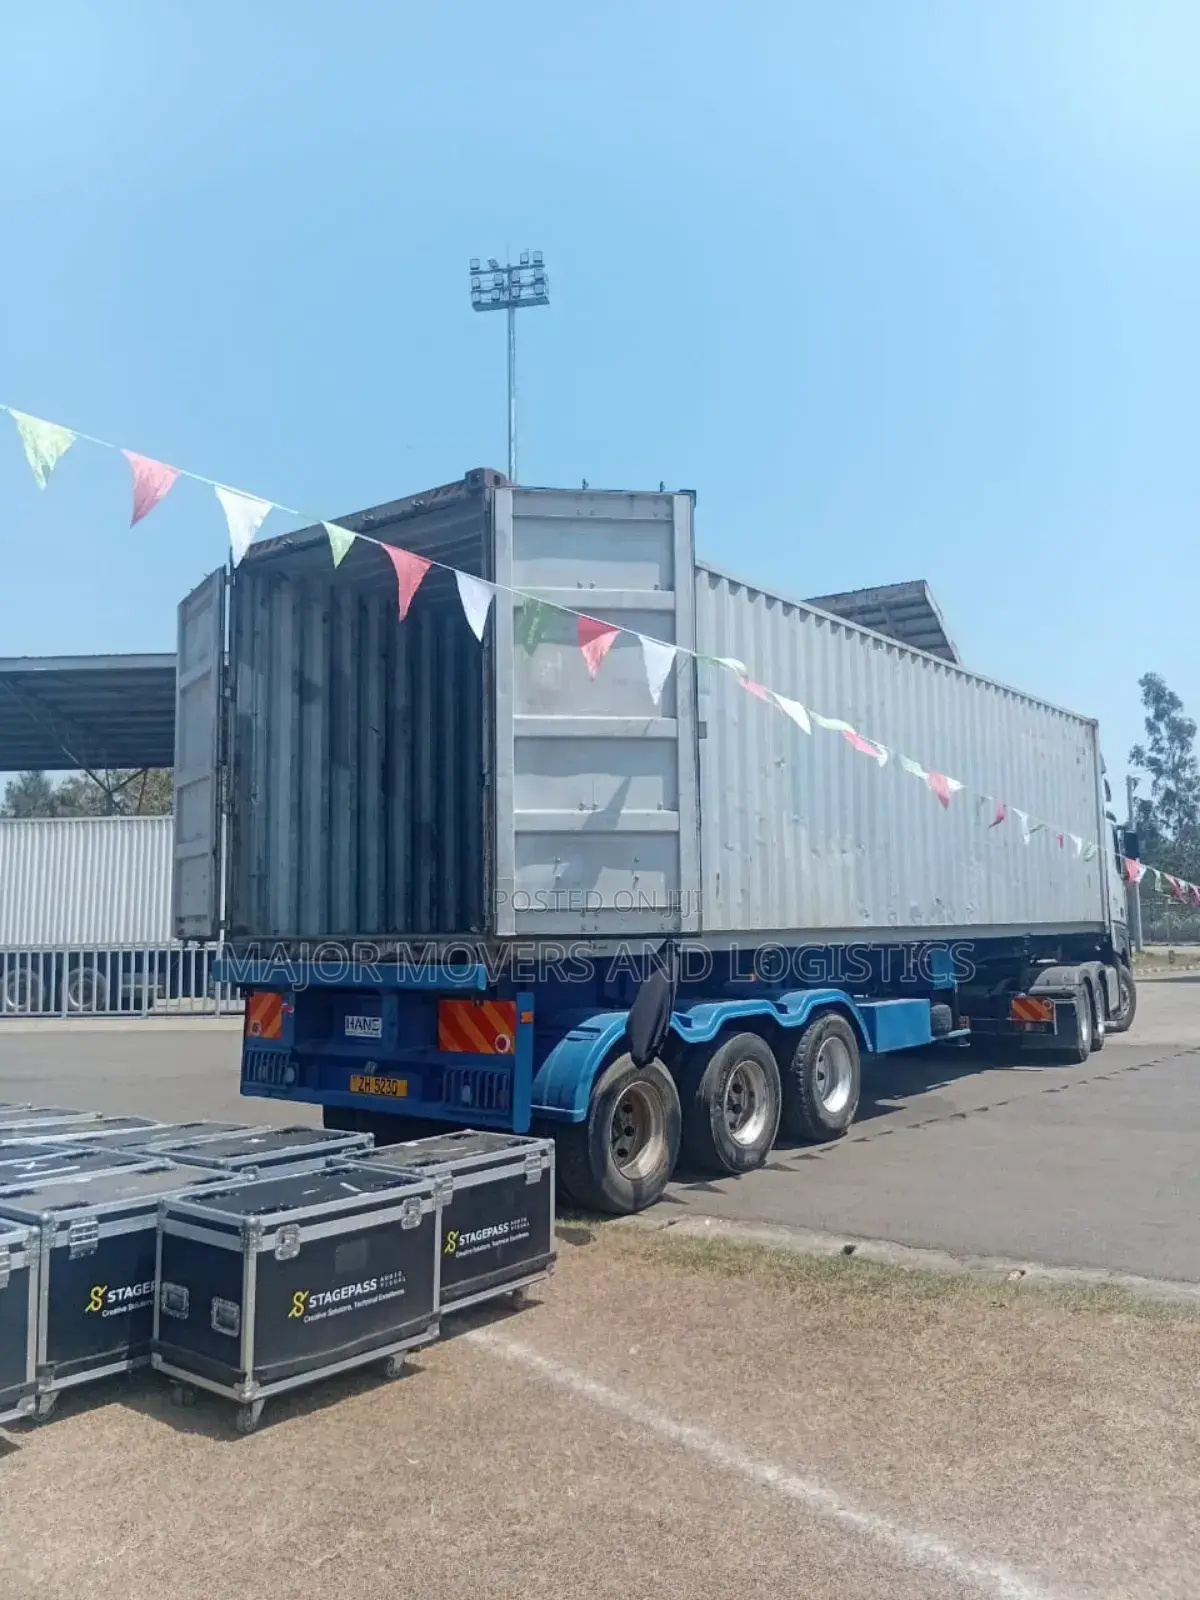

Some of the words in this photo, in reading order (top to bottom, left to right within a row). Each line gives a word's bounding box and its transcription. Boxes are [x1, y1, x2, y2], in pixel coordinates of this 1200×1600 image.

[358, 1077, 370, 1092] ZH
[459, 1222, 510, 1246] STAGEPASS
[308, 1278, 378, 1309] STAGEPASS
